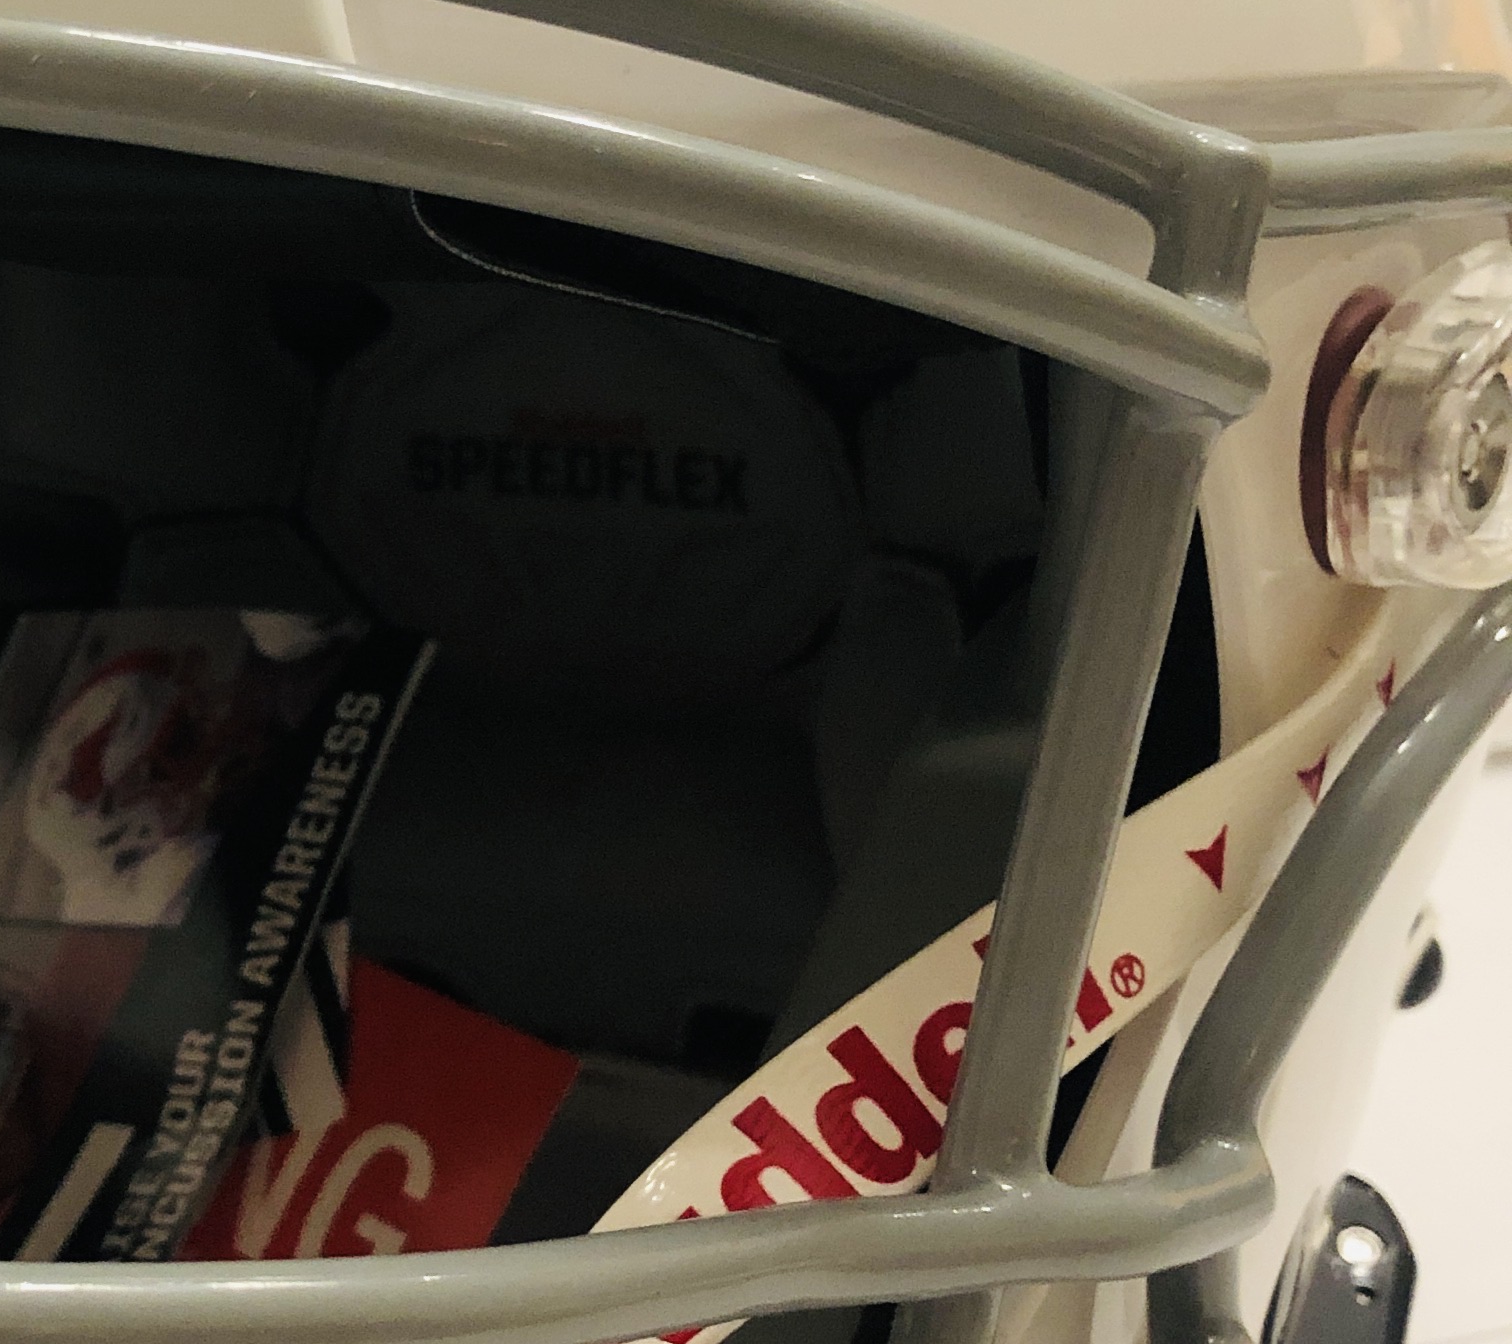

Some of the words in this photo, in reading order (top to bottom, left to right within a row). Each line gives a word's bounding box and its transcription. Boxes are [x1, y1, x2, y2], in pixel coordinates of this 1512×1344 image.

[404, 432, 749, 516] SPEEDFLEX
[133, 998, 266, 1261] NCUSSION
[240, 689, 384, 989] AWARENESS
[146, 1028, 216, 1158] YOUR
